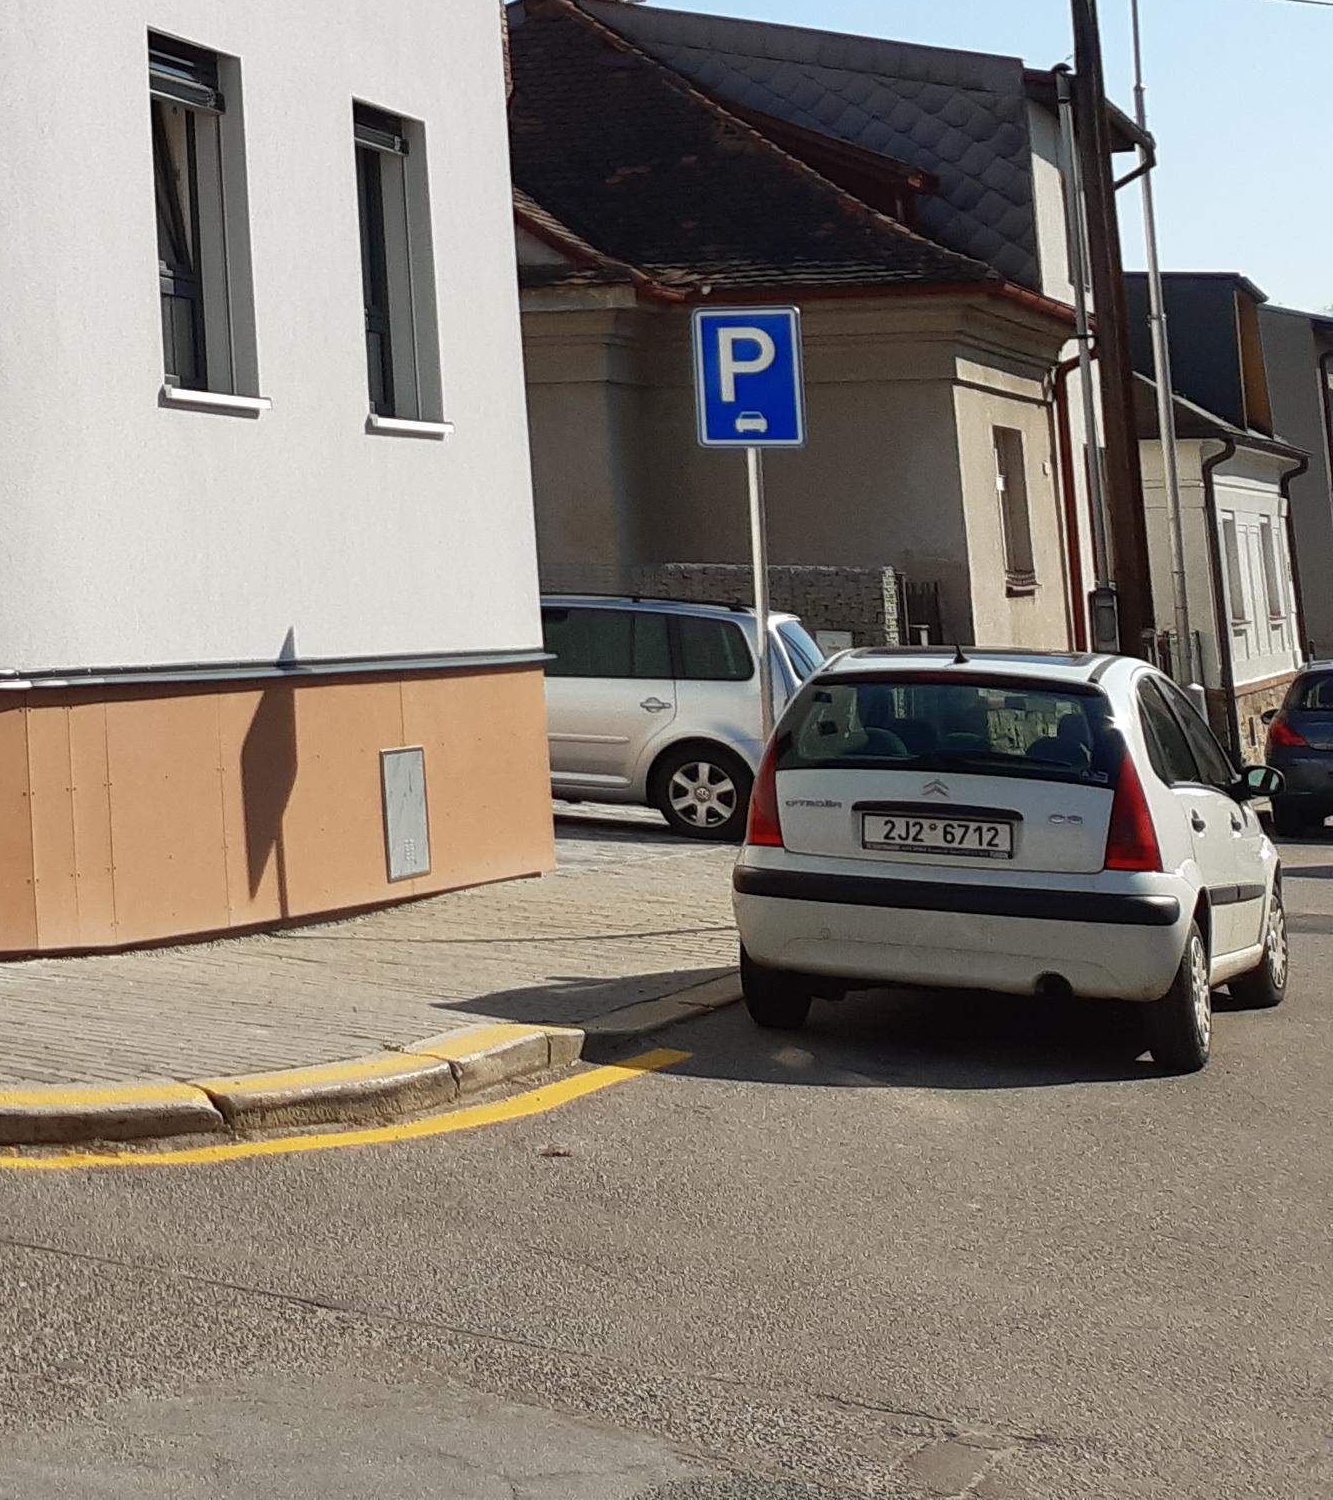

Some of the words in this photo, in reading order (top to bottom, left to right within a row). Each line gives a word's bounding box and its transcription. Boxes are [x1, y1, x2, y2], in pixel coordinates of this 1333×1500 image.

[717, 327, 775, 402] P
[883, 819, 924, 842] 2J2
[943, 824, 999, 847] 6712
